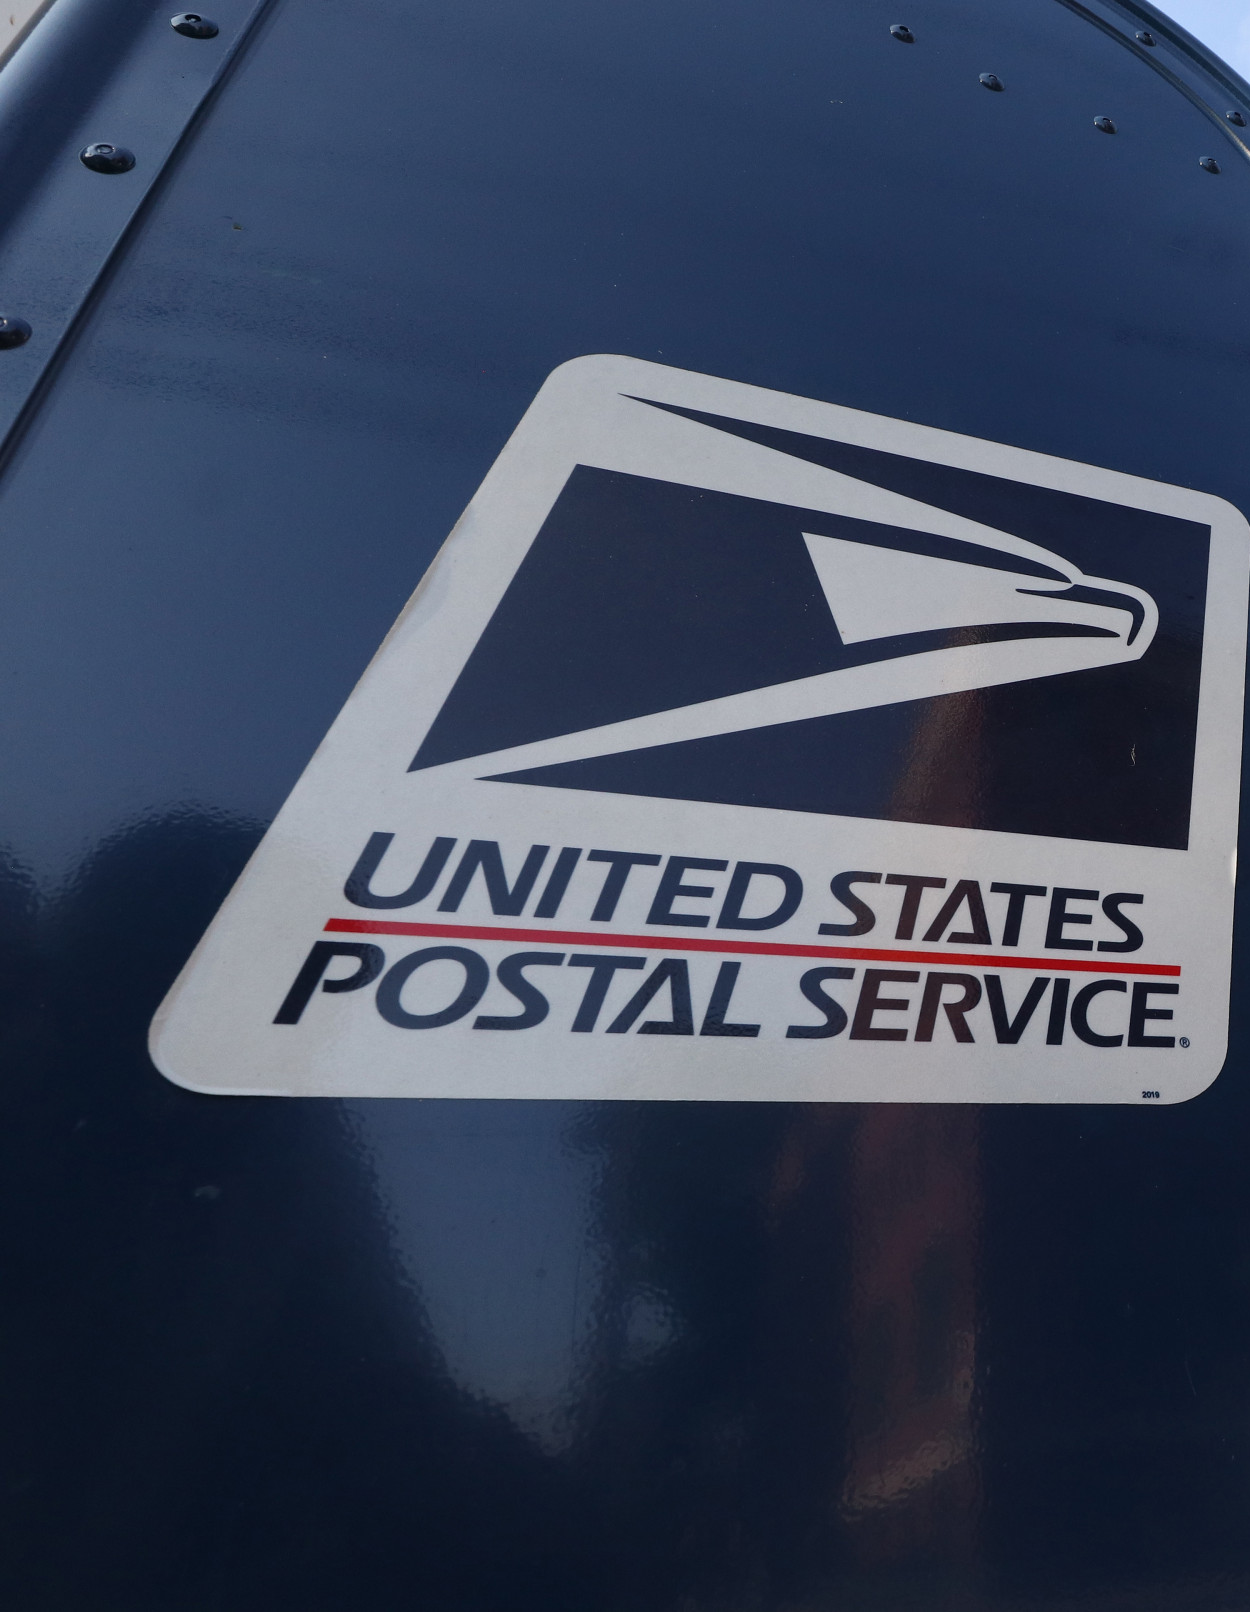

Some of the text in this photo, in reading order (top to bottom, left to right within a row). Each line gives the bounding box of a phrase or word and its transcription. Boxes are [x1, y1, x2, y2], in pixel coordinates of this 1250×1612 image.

[343, 831, 1144, 953] UNITED STATES
[272, 940, 761, 1038] POSTAL
[1141, 1090, 1160, 1099] 2019
